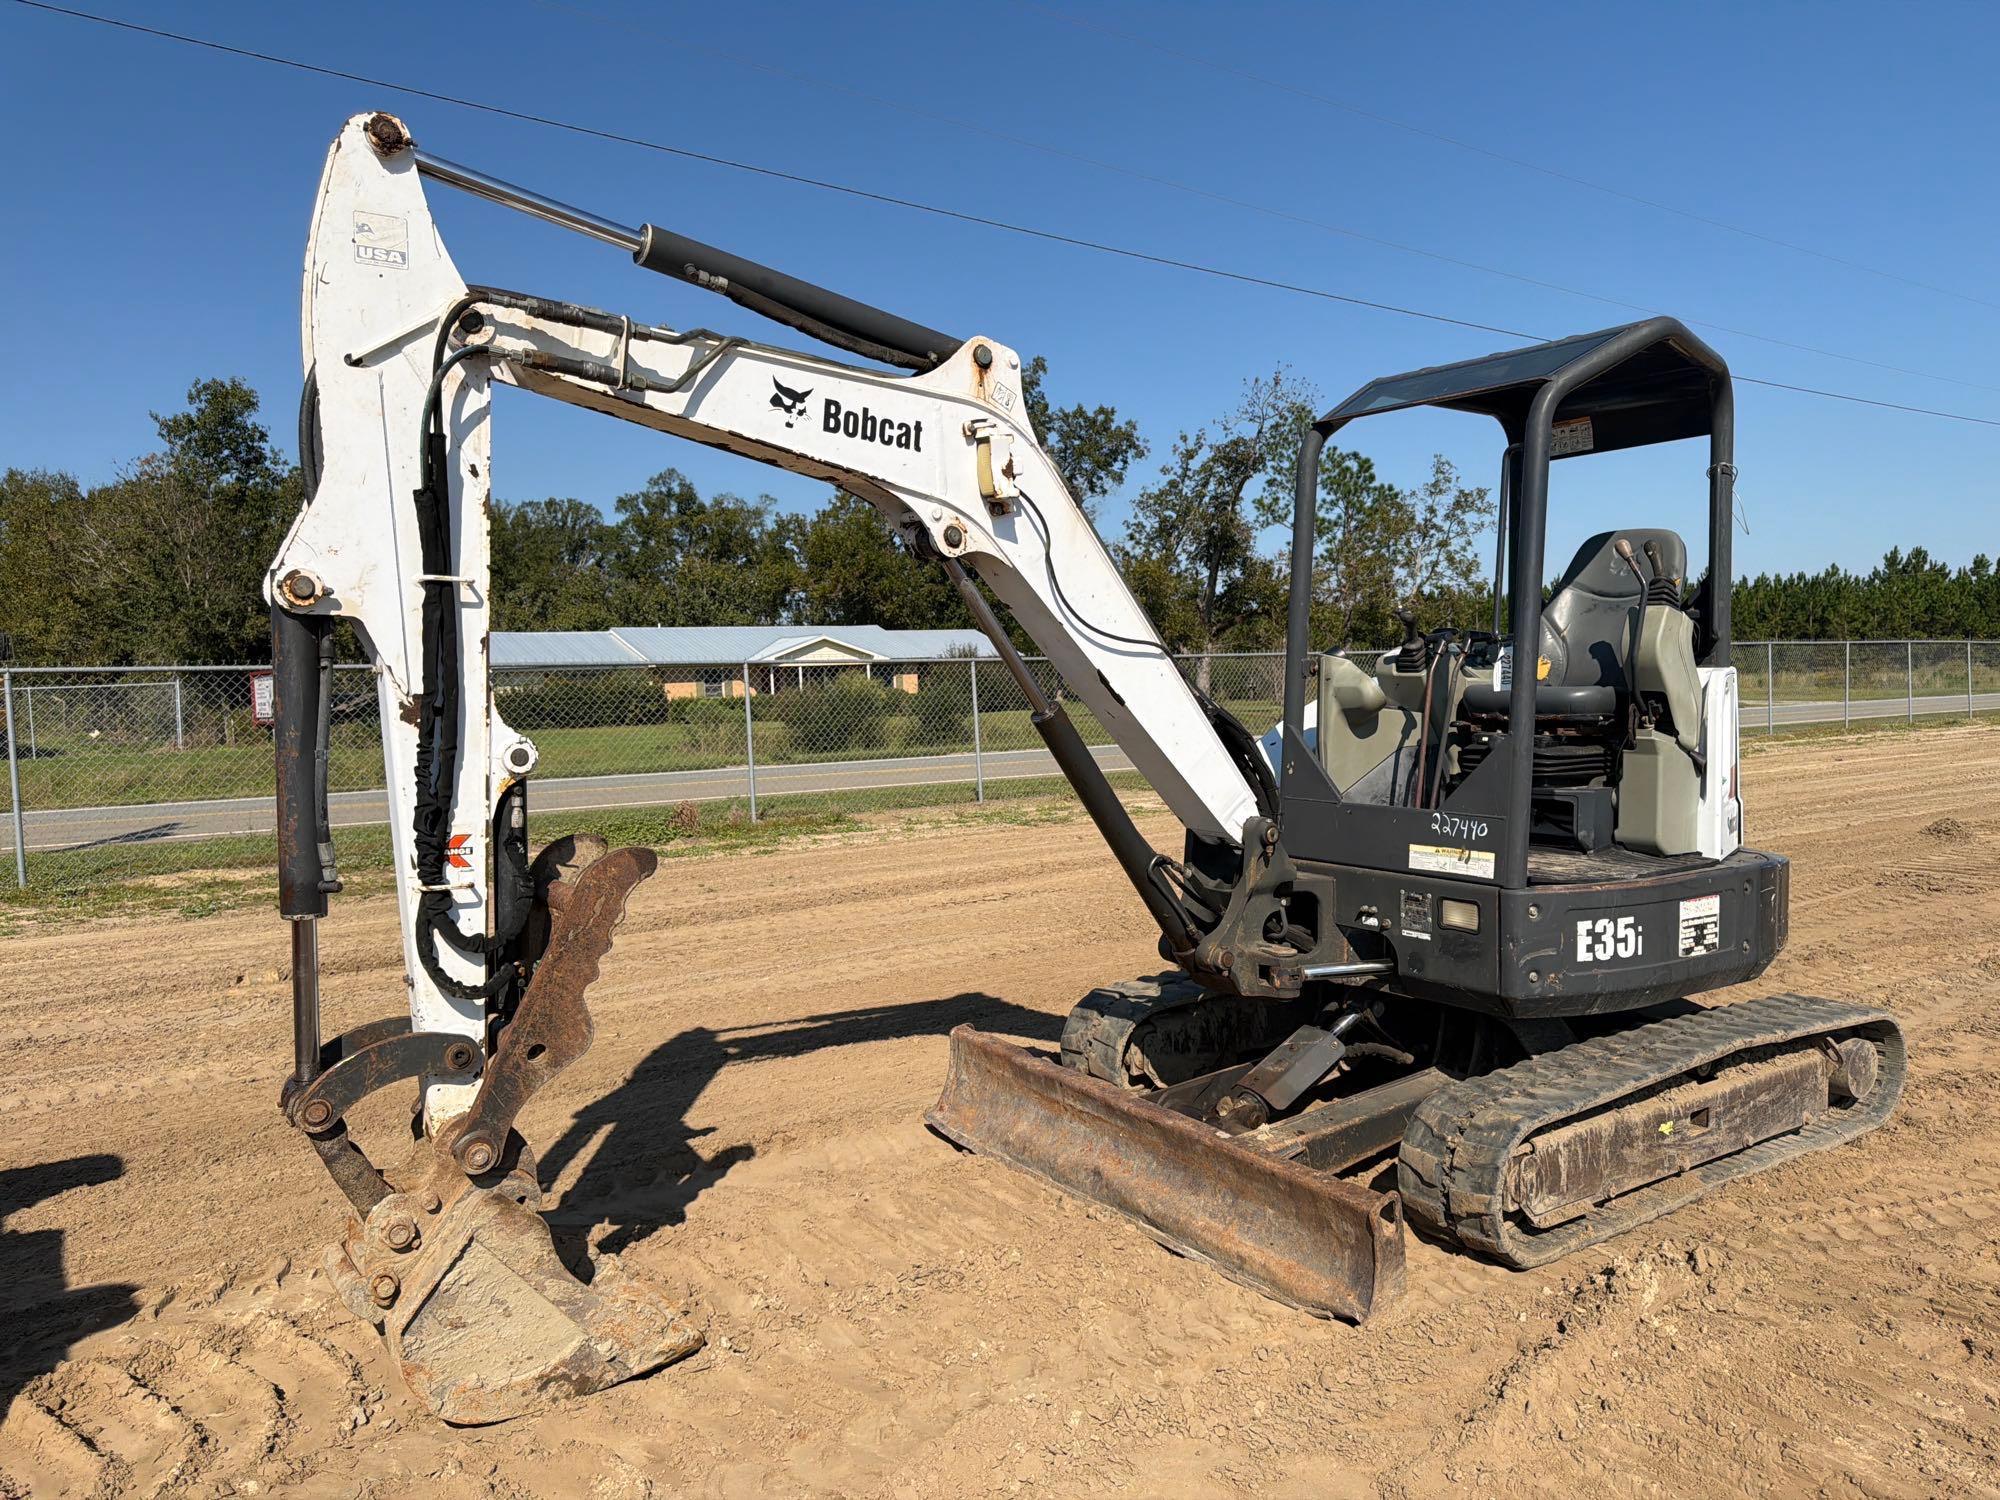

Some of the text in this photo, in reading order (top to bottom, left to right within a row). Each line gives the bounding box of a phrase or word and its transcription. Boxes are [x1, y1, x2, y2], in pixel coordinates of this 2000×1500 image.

[358, 246, 404, 264] USA
[822, 397, 922, 453] Bobcat
[1431, 812, 1488, 841] 227440
[1576, 916, 1643, 962] E35i
